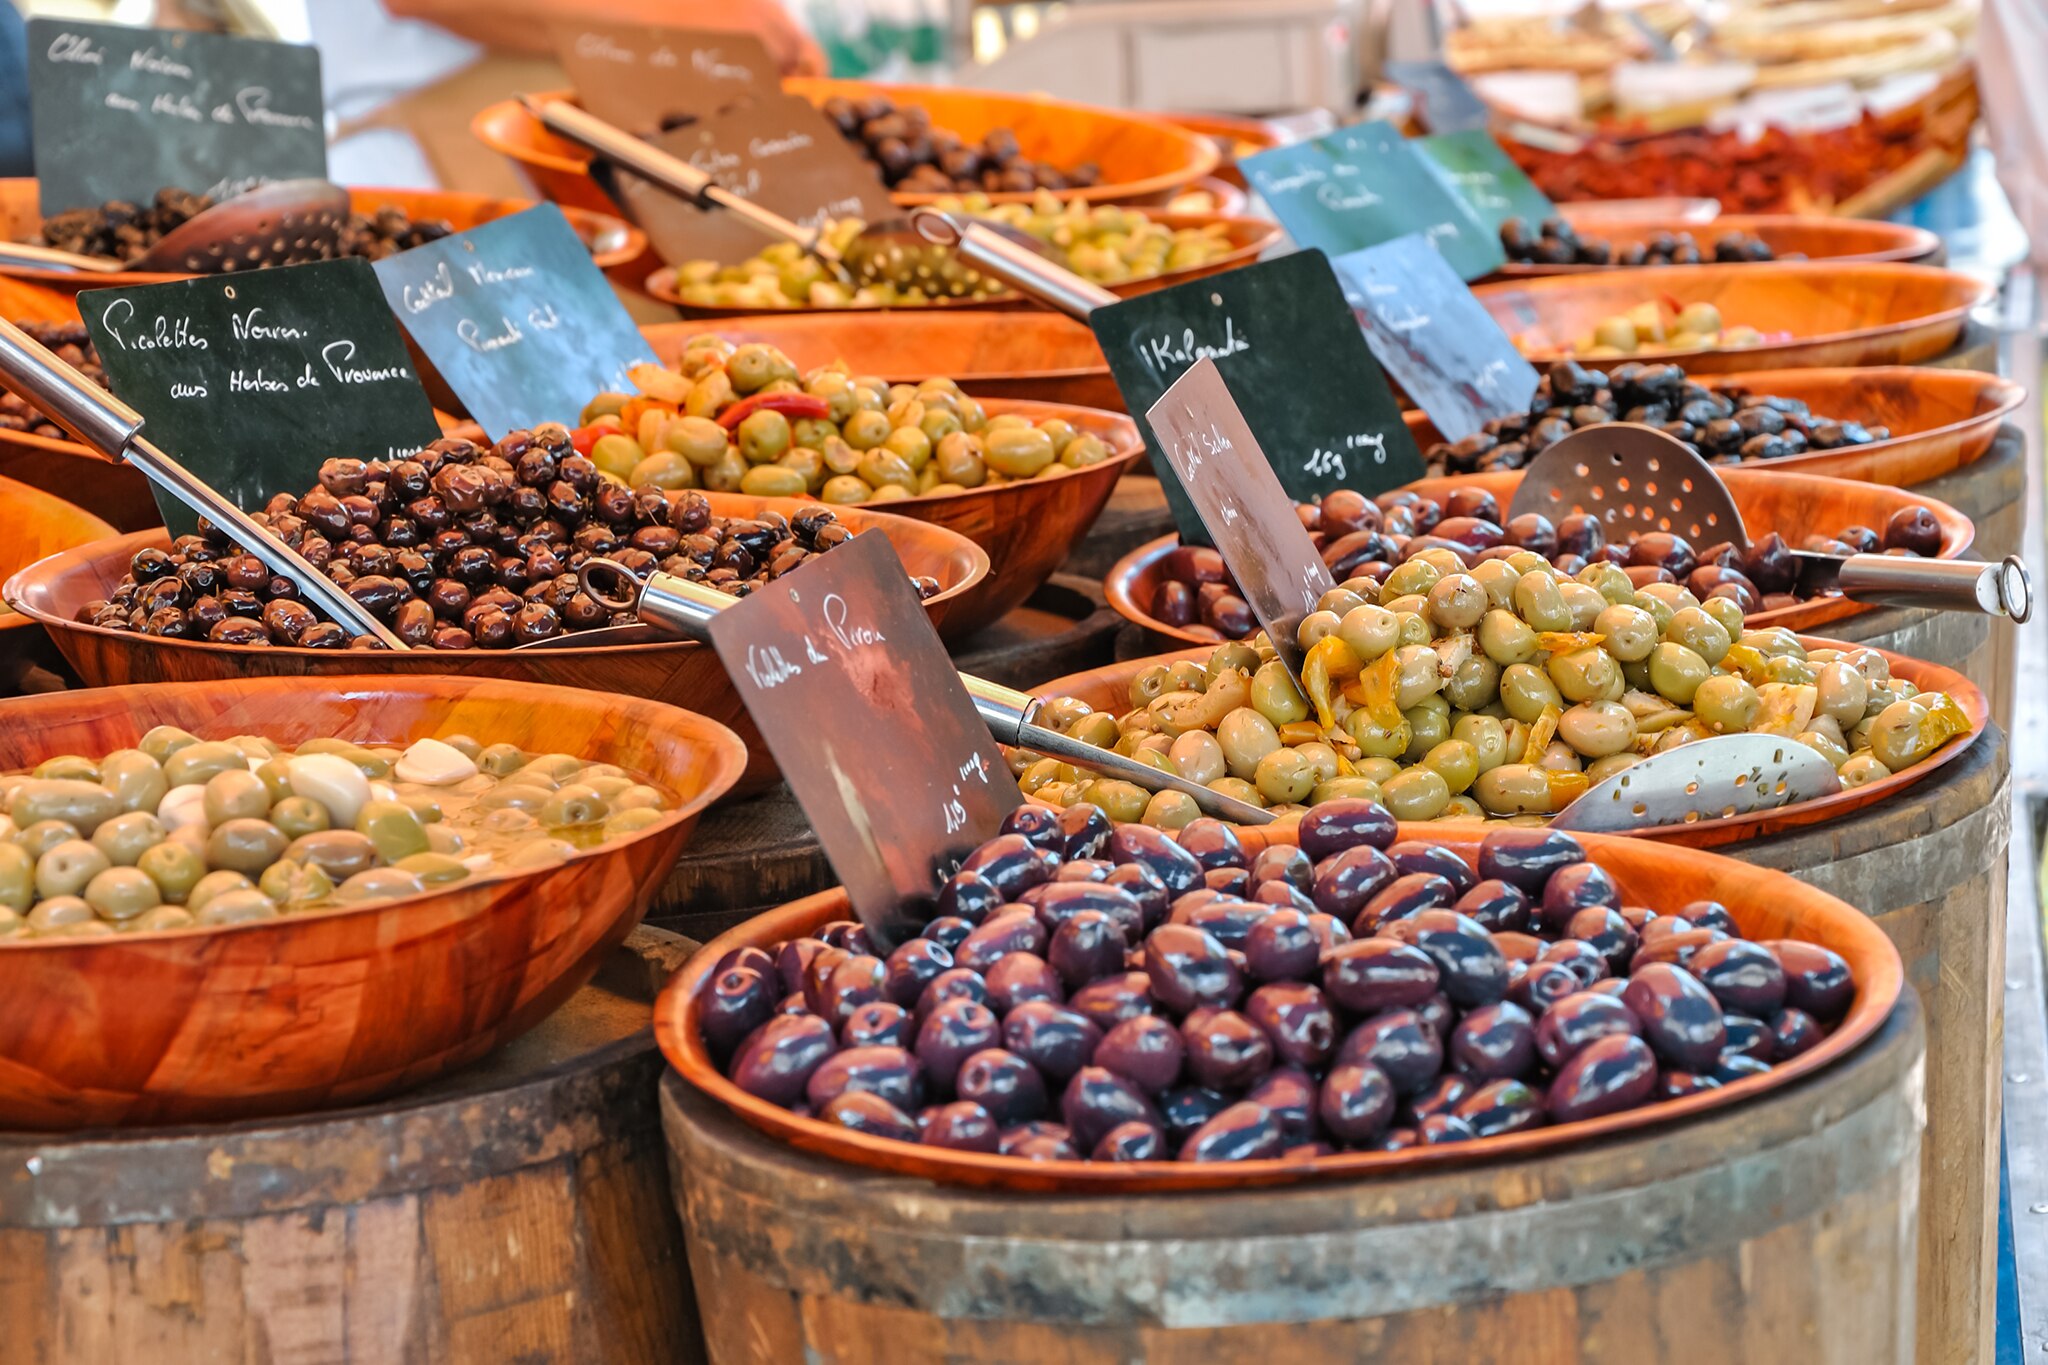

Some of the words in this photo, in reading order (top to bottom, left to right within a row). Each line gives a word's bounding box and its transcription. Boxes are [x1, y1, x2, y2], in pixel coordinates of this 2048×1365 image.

[230, 367, 289, 392] Herbes
[296, 362, 320, 388] de
[321, 339, 411, 383] Provence
